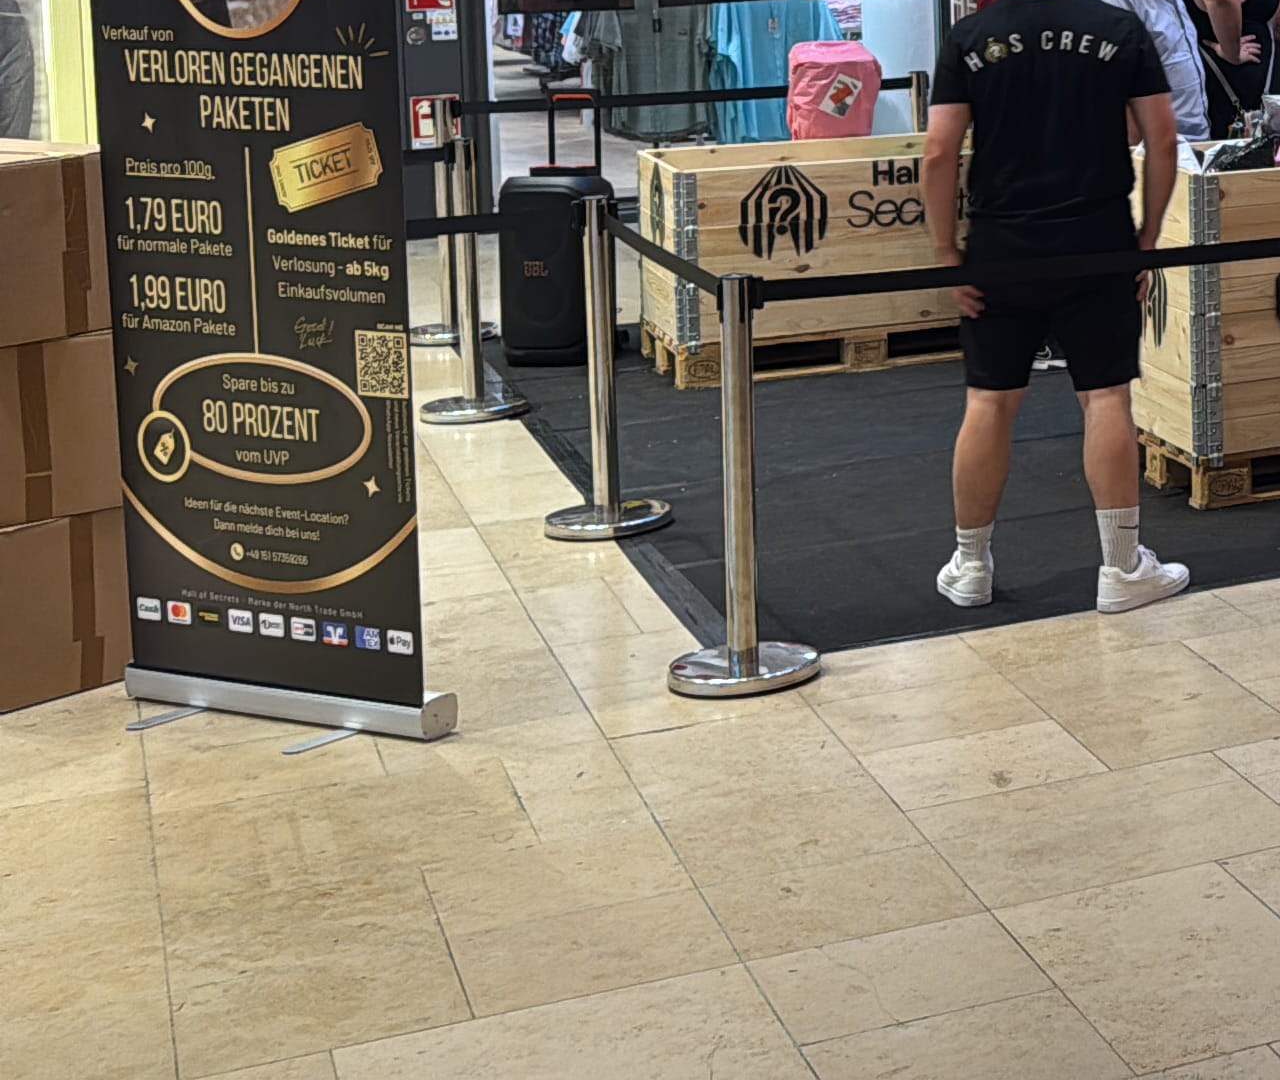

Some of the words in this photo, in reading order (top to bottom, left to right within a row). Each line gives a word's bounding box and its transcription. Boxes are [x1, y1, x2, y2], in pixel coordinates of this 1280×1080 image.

[101, 24, 149, 42] Verkauf
[151, 27, 174, 42] von
[1040, 30, 1119, 62] CREW
[124, 48, 227, 86] VERLOREN
[229, 51, 364, 90] GEGANGENEN
[199, 94, 291, 132] PAKETEN
[125, 157, 158, 175] Preis
[160, 161, 182, 178] pro
[292, 147, 354, 185] TICKET
[872, 157, 919, 187] Hal
[125, 195, 168, 234] 1,79
[170, 198, 223, 236] EURO
[116, 234, 134, 251] für
[137, 237, 188, 254] normale
[190, 238, 234, 257] Pakete
[267, 227, 328, 247] Goldenes
[328, 231, 371, 251] Ticket
[372, 234, 393, 251] für
[271, 255, 336, 278] Verlosung
[345, 260, 362, 276] ab
[364, 262, 391, 281] 5kg
[129, 273, 172, 313] 1,99
[174, 276, 227, 314] EURO
[277, 281, 386, 305] Einkaufsvolumen
[121, 312, 140, 330] für
[142, 314, 192, 333] Amazon
[193, 317, 237, 337] Pakete
[222, 373, 258, 394] Spare
[260, 376, 279, 394] bis
[280, 380, 295, 395] zu
[202, 398, 229, 435] 80
[231, 401, 321, 443] PROZENT
[234, 449, 262, 465] vom
[263, 449, 290, 466] UVP
[184, 496, 209, 510] Ideen
[209, 498, 222, 512] für
[223, 500, 237, 513] die
[238, 503, 274, 518] nächste
[275, 506, 350, 526] Event-Location?
[213, 517, 236, 532] Dann
[236, 521, 263, 536] melde
[264, 523, 285, 537] dich
[285, 525, 300, 539] bei
[300, 528, 321, 541] uns!
[230, 613, 252, 627] VISA
